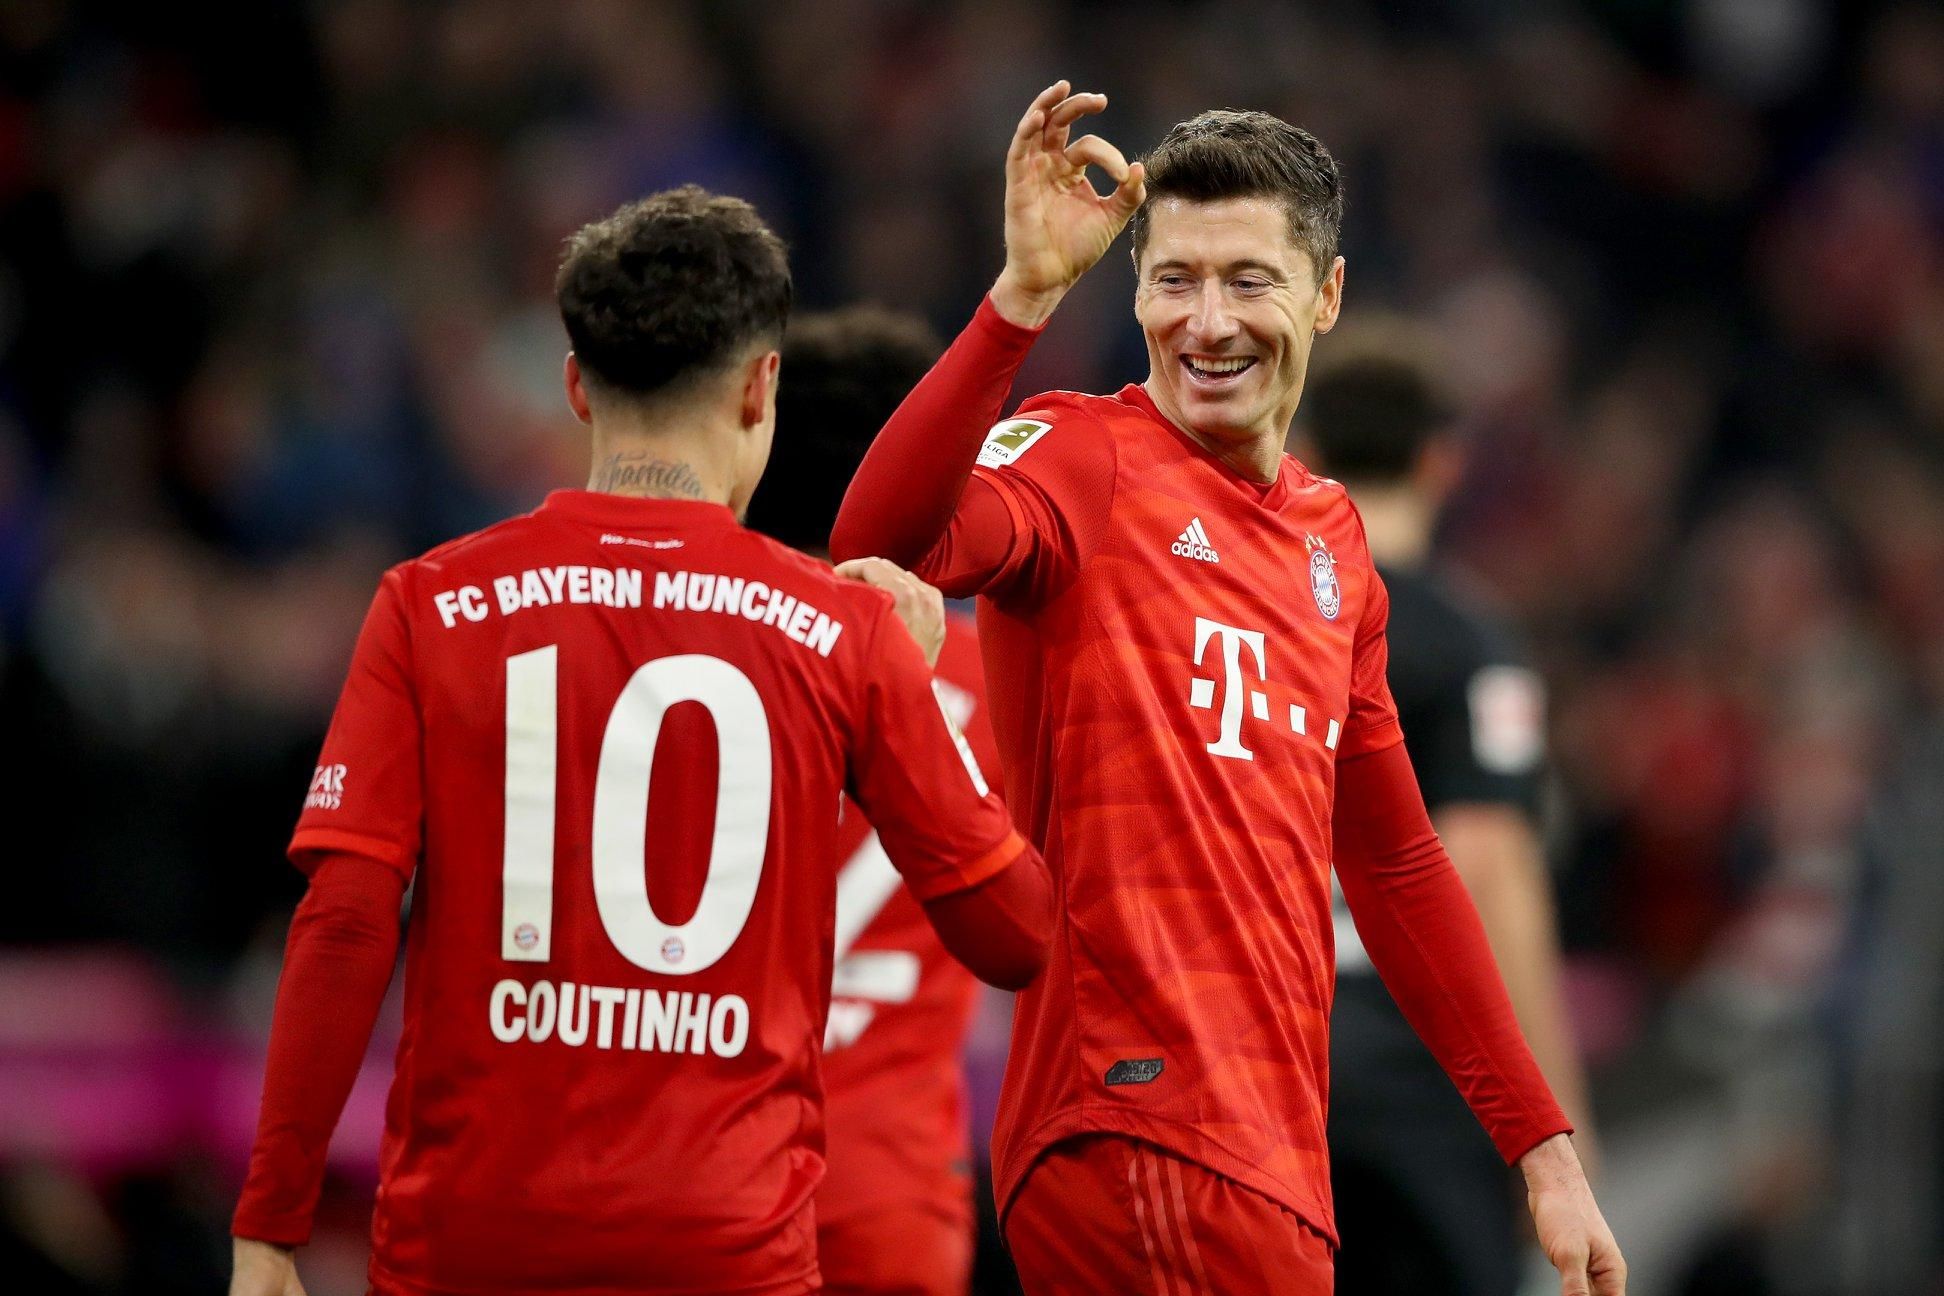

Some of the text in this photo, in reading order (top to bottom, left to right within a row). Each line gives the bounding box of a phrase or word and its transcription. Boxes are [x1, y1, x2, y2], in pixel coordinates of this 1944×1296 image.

[1171, 541, 1220, 564] adidas
[434, 565, 843, 658] FC BAYERN MÜNCHEN
[501, 643, 773, 976] 10
[489, 978, 750, 1059] COUTINHO
